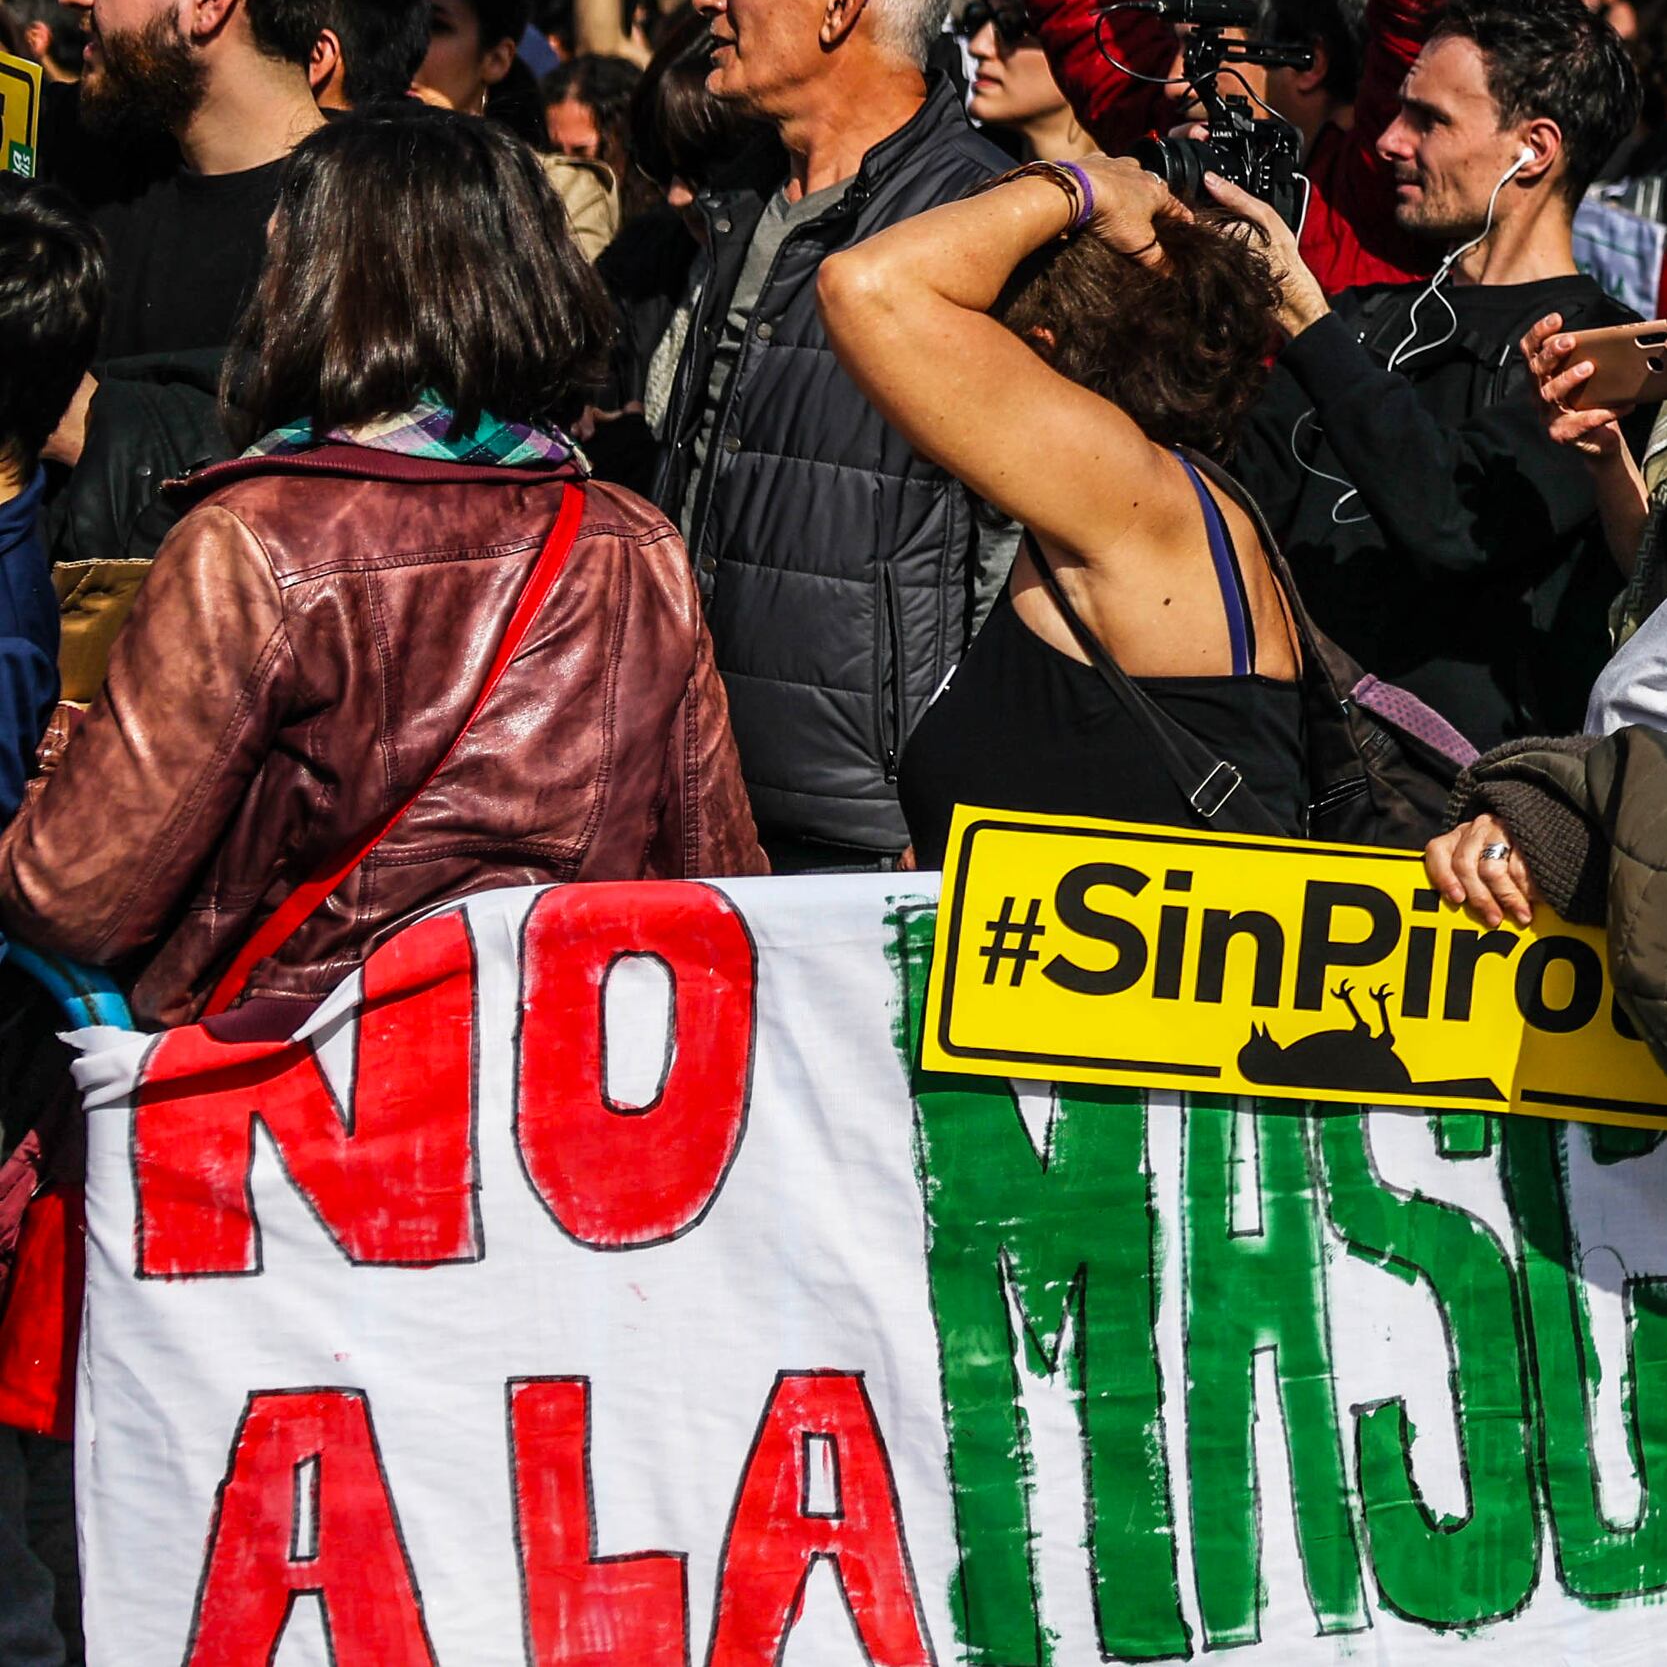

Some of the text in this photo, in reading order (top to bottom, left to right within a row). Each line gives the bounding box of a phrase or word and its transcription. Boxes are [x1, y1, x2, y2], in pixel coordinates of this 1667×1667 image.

[133, 880, 757, 1280] NO
[185, 1369, 936, 1667] A LA
